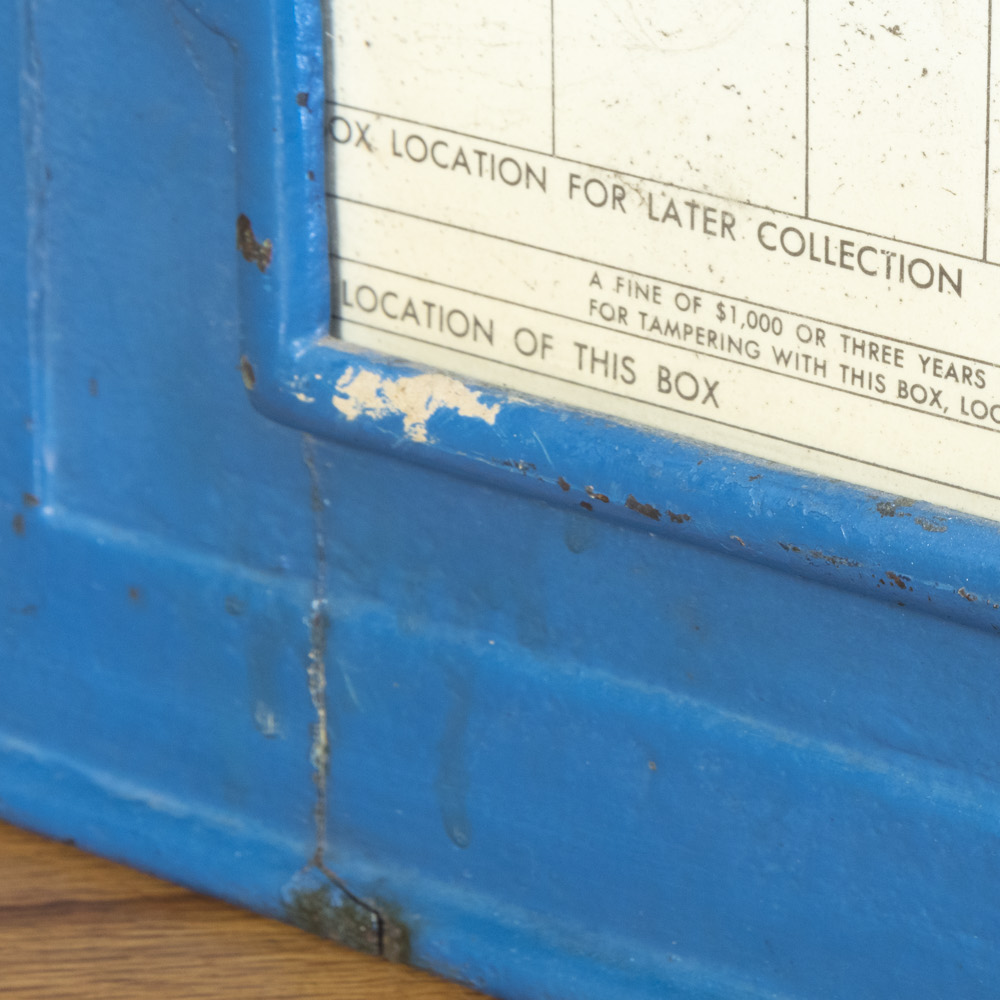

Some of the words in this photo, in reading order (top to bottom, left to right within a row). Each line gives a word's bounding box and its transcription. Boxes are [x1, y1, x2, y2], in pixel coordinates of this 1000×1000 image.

[391, 128, 548, 192] LOCATION
[568, 173, 627, 214] FOR
[647, 192, 737, 241] LATER
[757, 221, 964, 298] COLLECTION
[341, 280, 495, 347] LOCATION
[514, 327, 554, 361] OF
[573, 342, 637, 387] THIS
[657, 365, 721, 409] BOX
[588, 298, 629, 327] FOR
[638, 310, 762, 361] TAMPERING
[772, 345, 828, 379] WITH
[839, 364, 888, 396] THIS
[897, 378, 951, 415] BOX,
[589, 271, 603, 290] A
[615, 275, 662, 305] FINE
[674, 292, 704, 316] OF
[715, 301, 784, 337] $1,000
[795, 323, 828, 348] OR
[840, 332, 905, 369] THREE
[918, 354, 988, 390] YEARS
